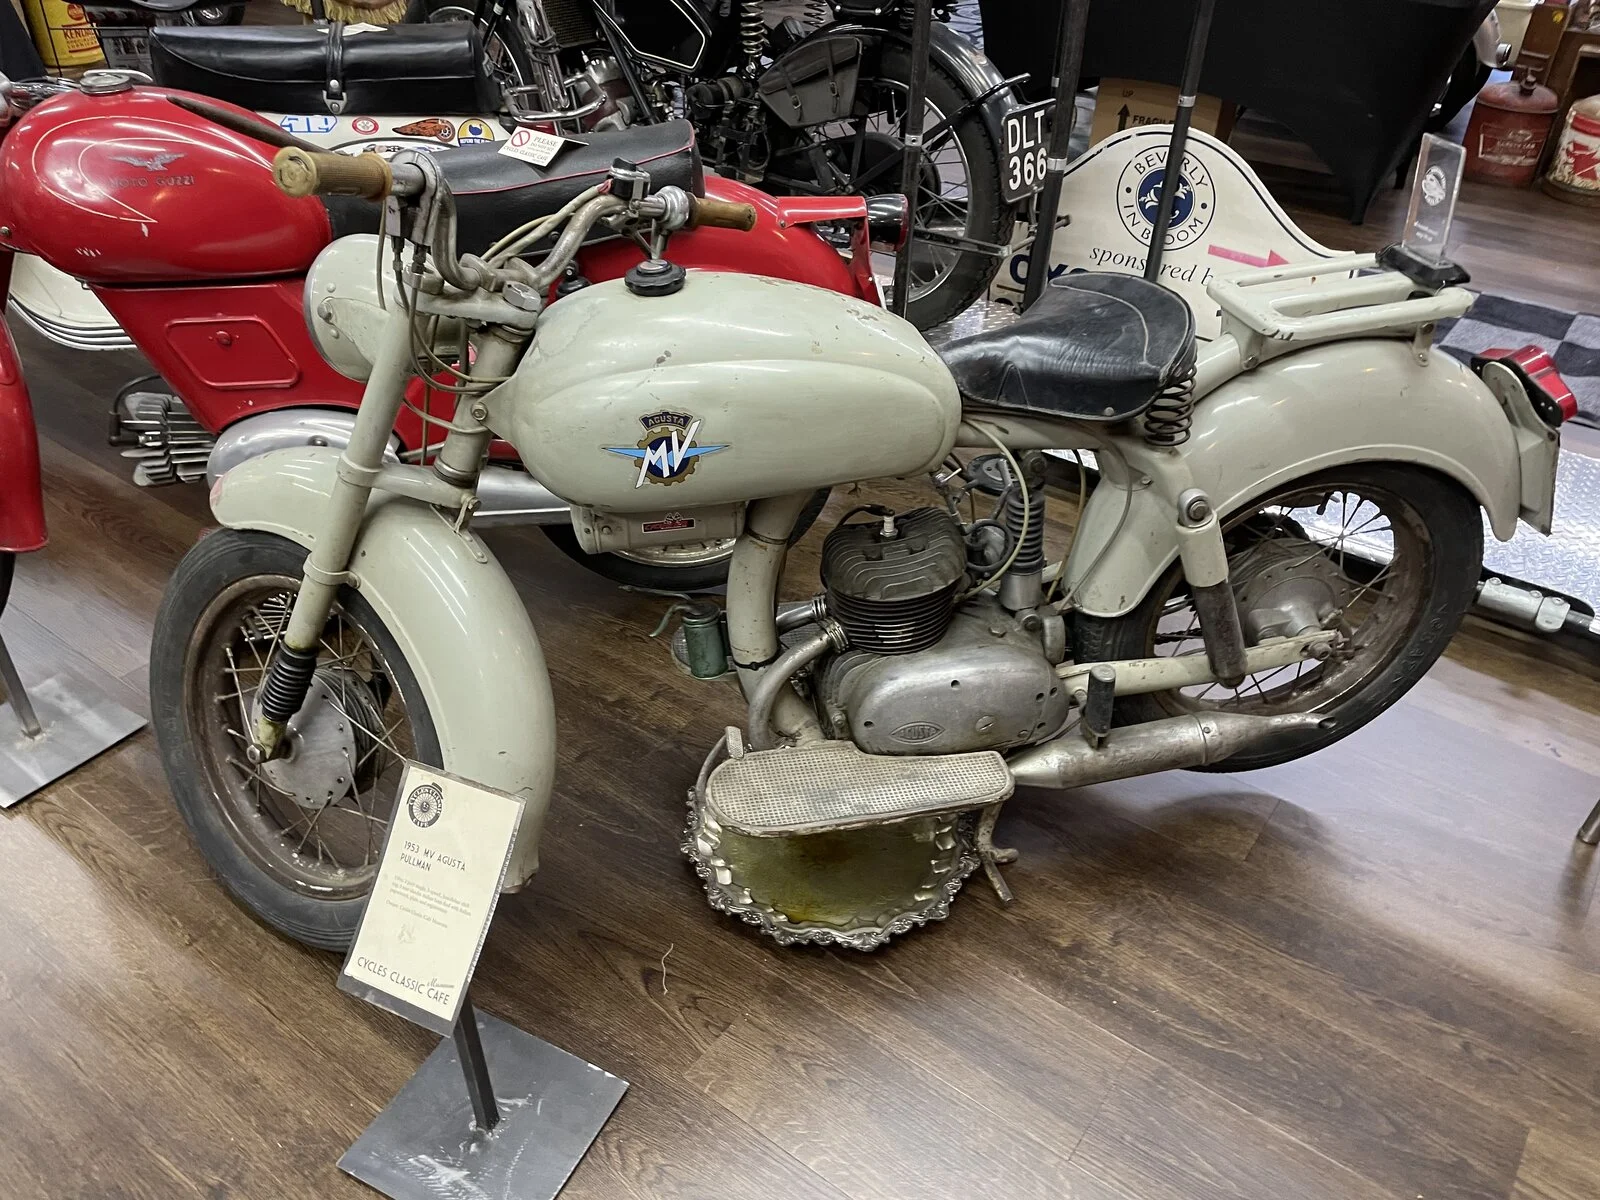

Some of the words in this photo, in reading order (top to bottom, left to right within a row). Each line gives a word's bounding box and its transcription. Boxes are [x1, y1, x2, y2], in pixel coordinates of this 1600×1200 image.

[1122, 89, 1134, 98] UP
[533, 136, 559, 148] PLEASE
[1007, 109, 1045, 154] DLT
[110, 177, 149, 189] MOTO
[155, 175, 195, 187] GUZZI
[1008, 148, 1047, 191] 366
[1134, 151, 1208, 186] BEVRLY
[1123, 204, 1141, 227] IN
[1140, 217, 1204, 246] BOOM
[1089, 246, 1197, 284] sponsred
[648, 415, 685, 427] AGUSTA
[635, 418, 701, 489] MV
[400, 852, 432, 871] PULLMAN
[404, 840, 420, 854] 1953
[423, 848, 436, 859] MV
[437, 853, 466, 871] AGUSTA
[357, 956, 388, 978] CYCLES
[389, 971, 426, 994] CLASSIC
[426, 987, 450, 1005] CAFE
